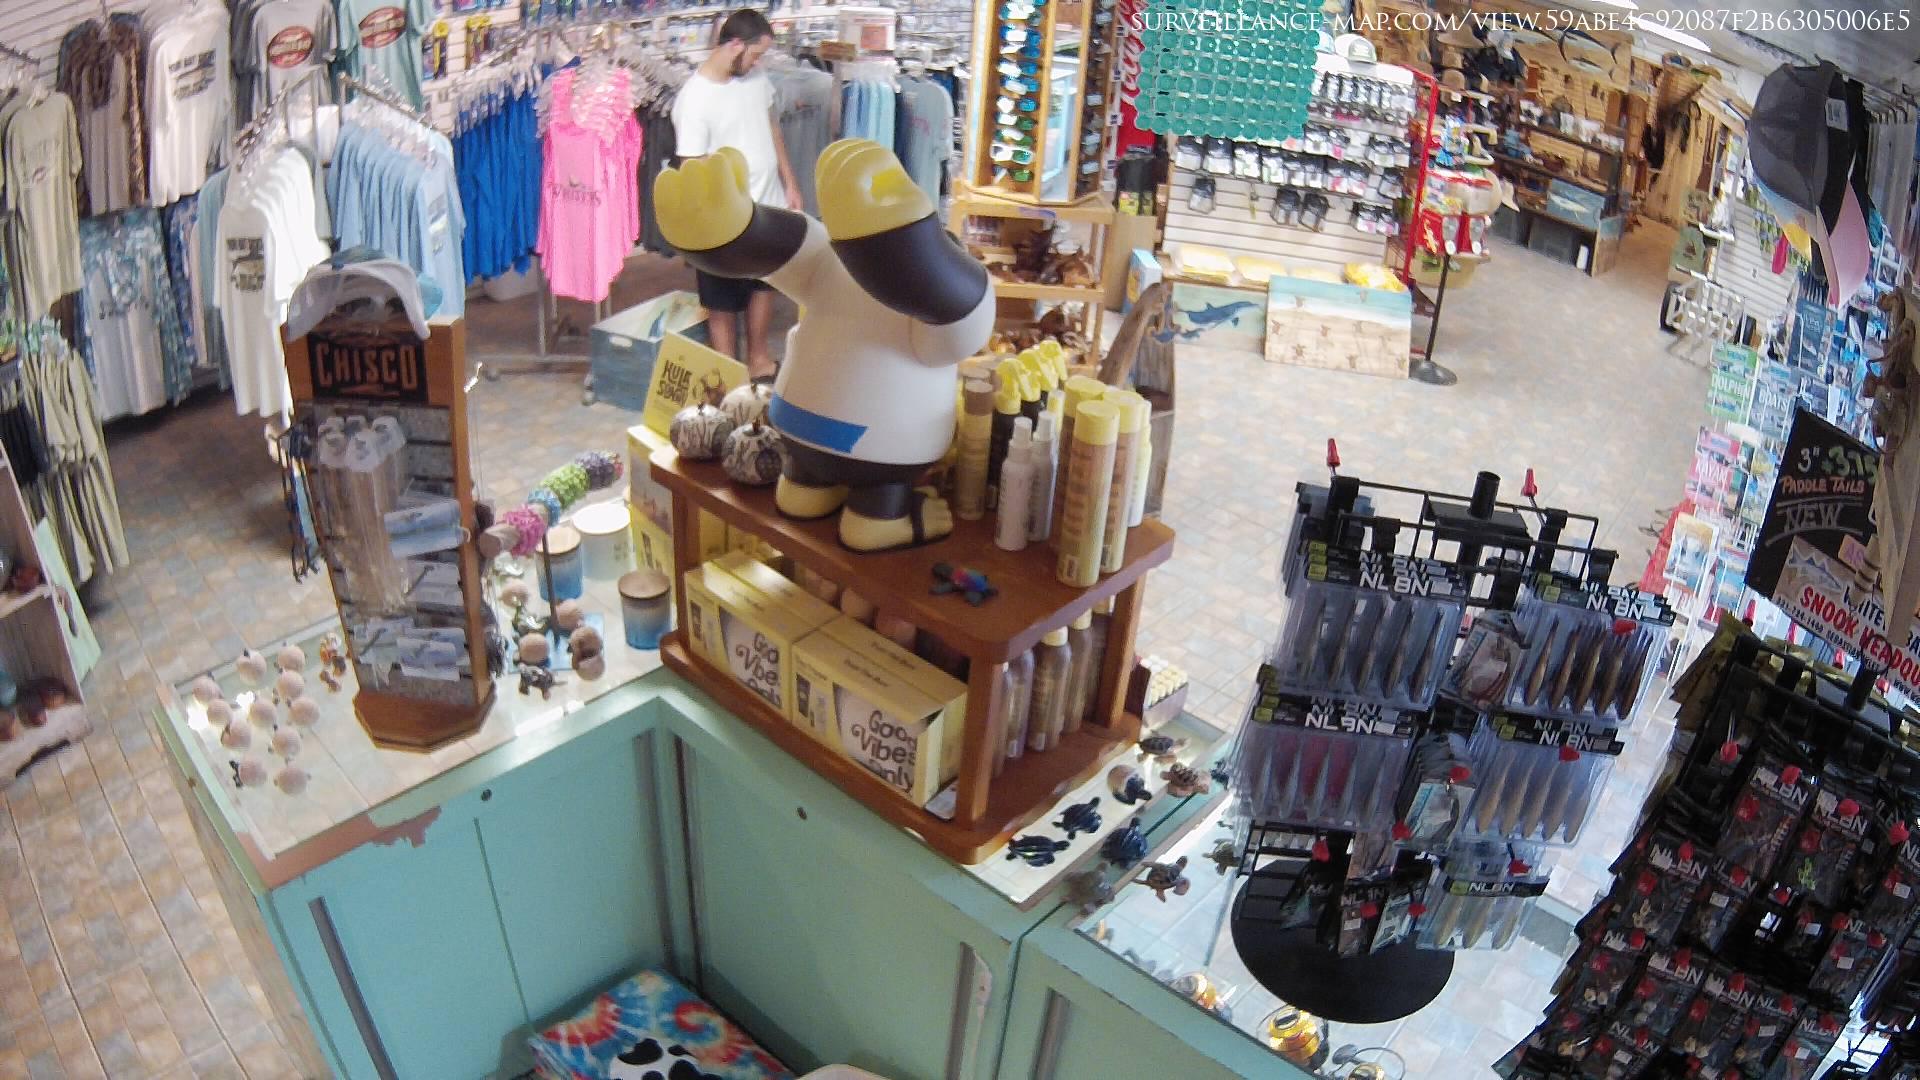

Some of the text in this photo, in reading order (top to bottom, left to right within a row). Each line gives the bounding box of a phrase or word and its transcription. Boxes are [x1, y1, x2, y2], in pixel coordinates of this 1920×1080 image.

[316, 342, 417, 390] CHISCO
[1784, 501, 1845, 533] NEW
[1800, 586, 1859, 639] SNOOK
